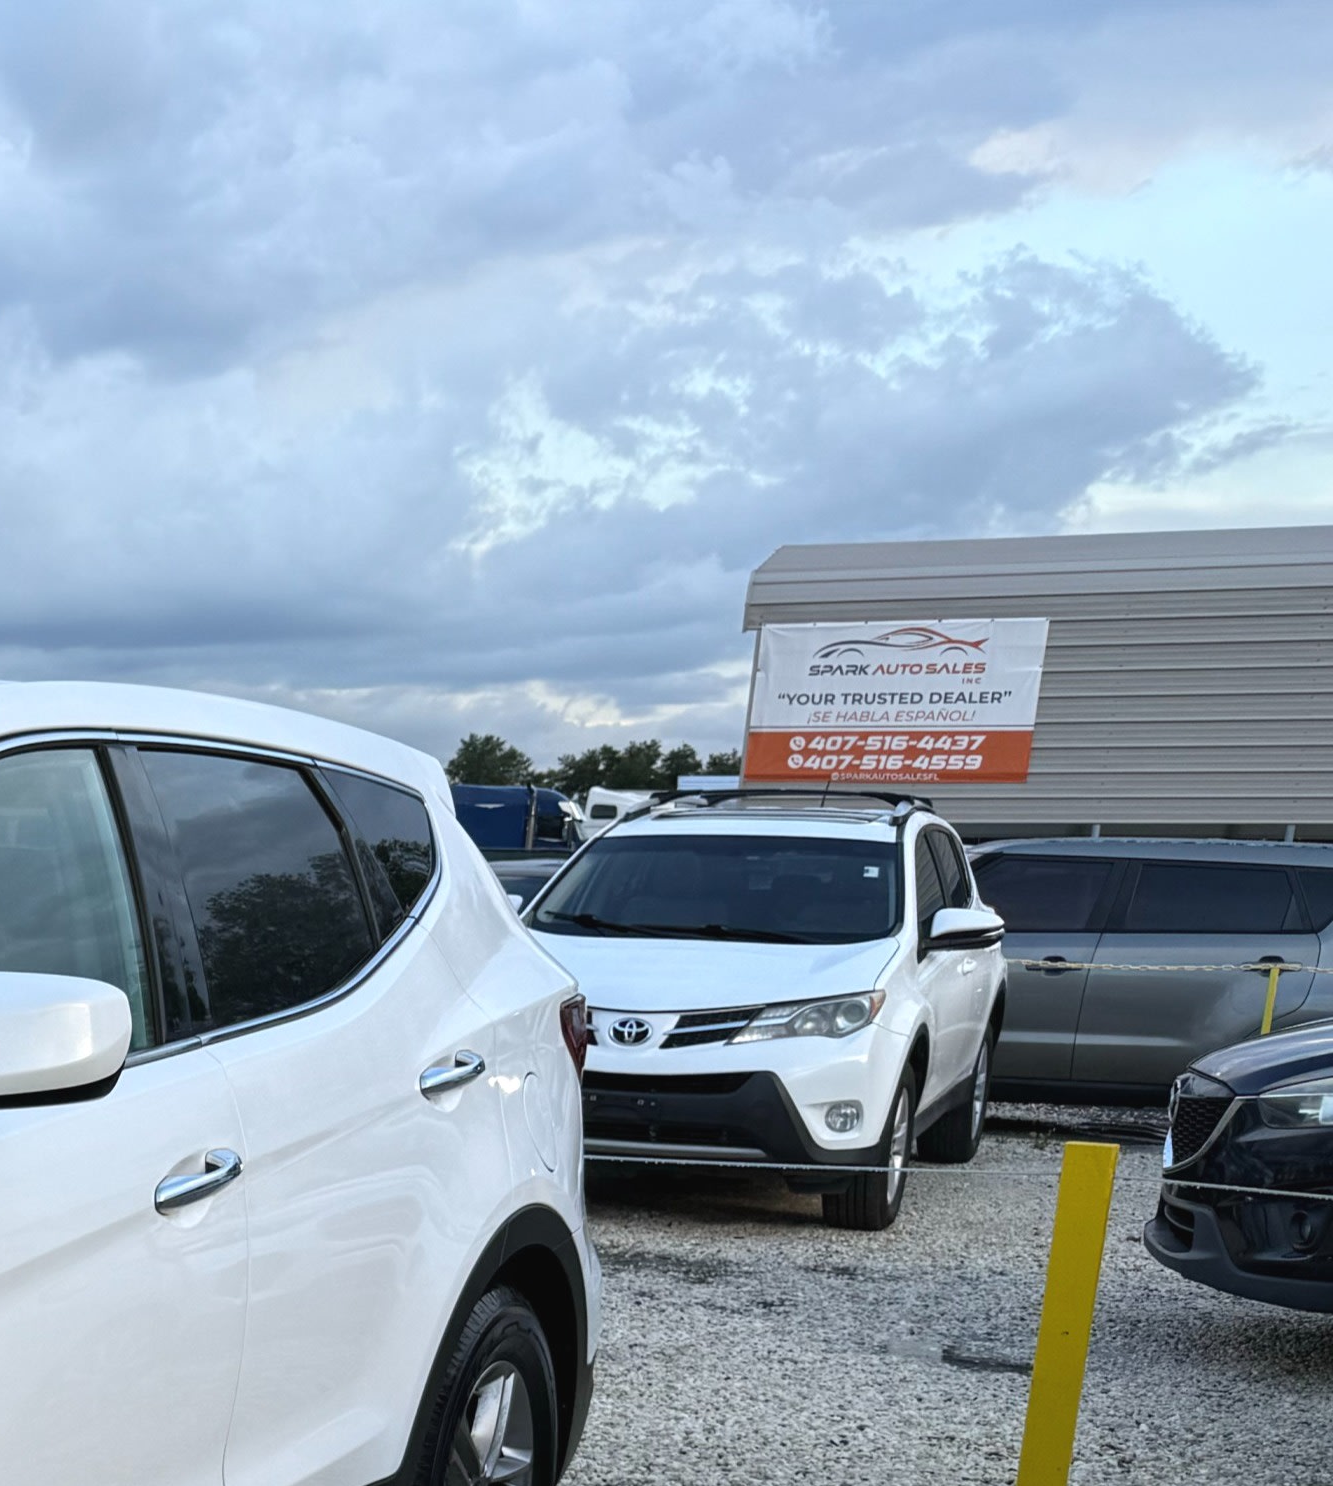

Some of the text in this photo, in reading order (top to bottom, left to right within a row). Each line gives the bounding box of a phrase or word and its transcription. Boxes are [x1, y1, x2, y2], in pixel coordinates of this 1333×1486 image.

[808, 662, 986, 676] SPARK AUTO SALES
[961, 677, 982, 685] INC
[841, 691, 924, 706] TRUSTED
[835, 710, 891, 723] HABLA
[893, 707, 976, 722] ESPAÑOL!
[807, 735, 986, 751] 407-516-4437
[802, 754, 983, 770] 407-516-4559
